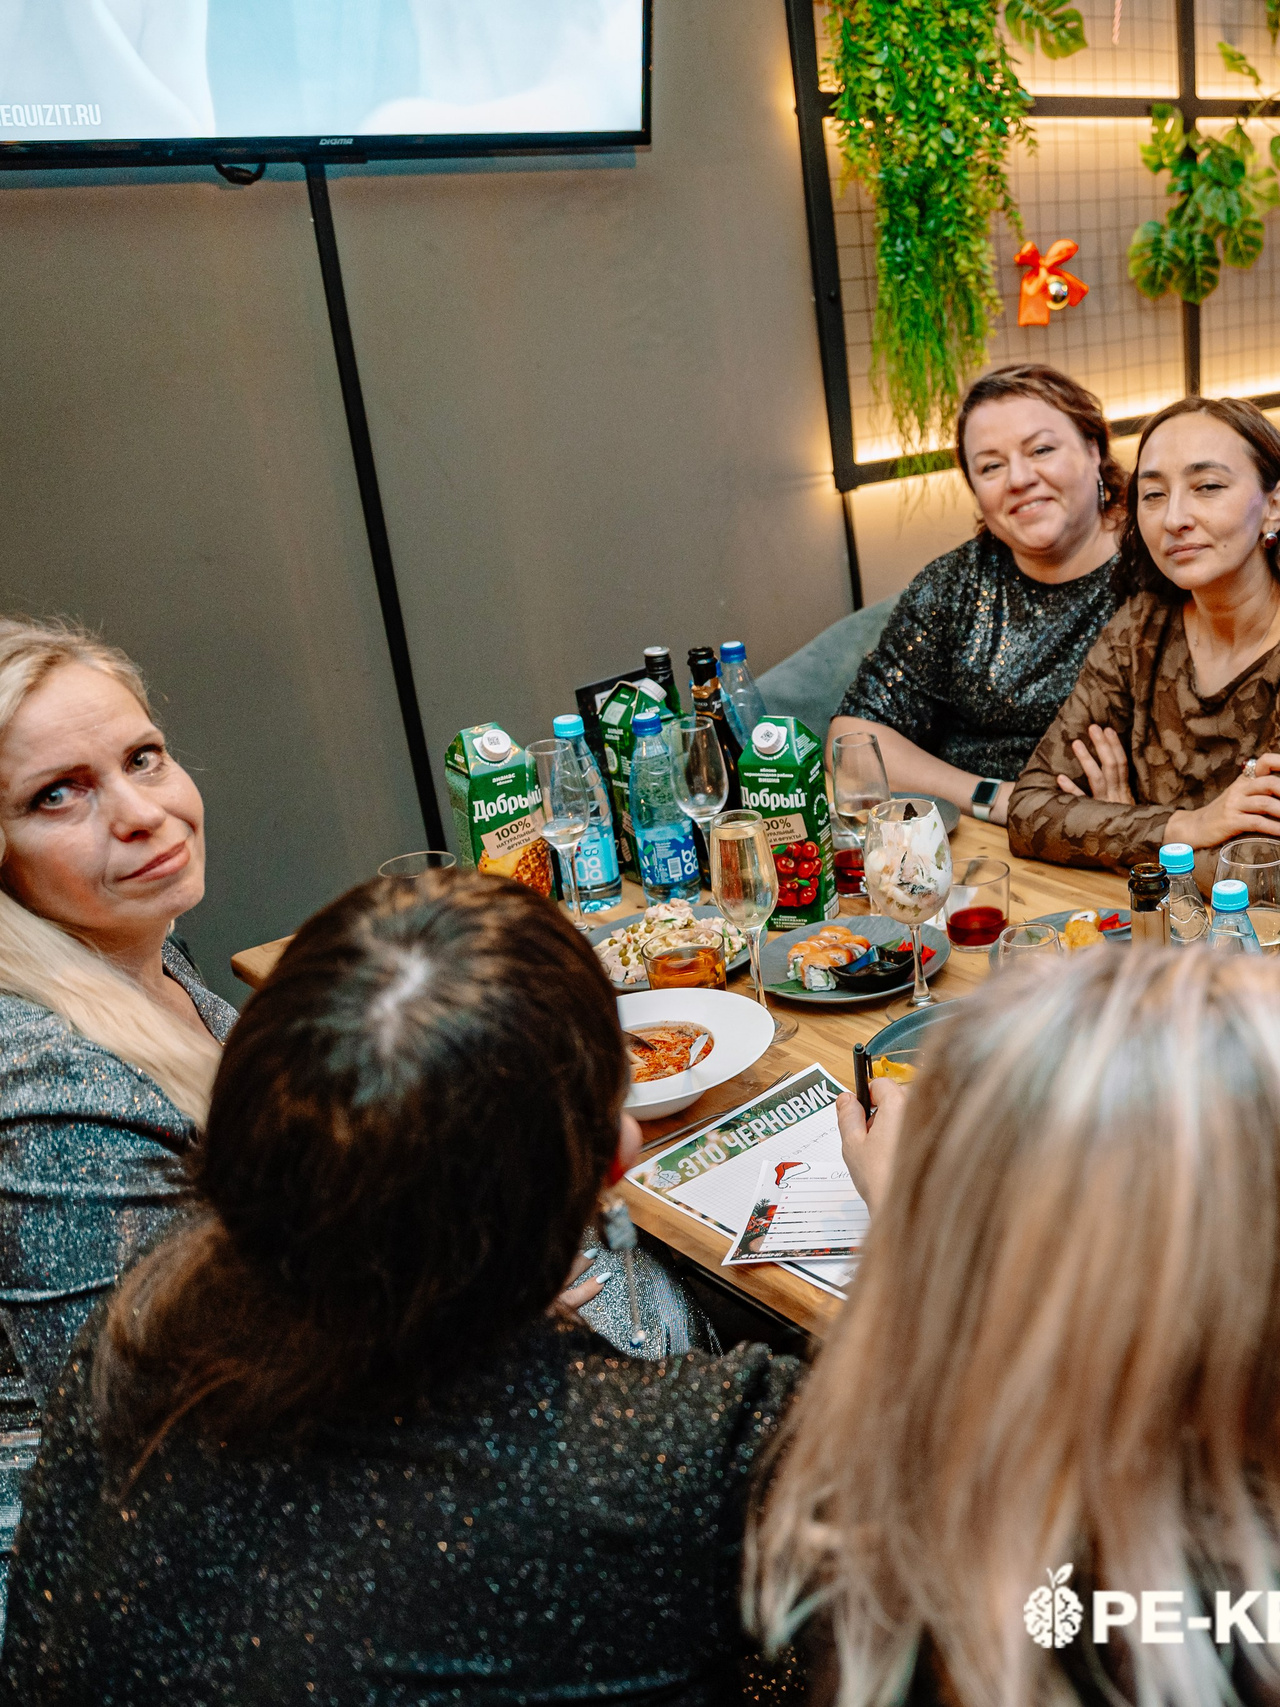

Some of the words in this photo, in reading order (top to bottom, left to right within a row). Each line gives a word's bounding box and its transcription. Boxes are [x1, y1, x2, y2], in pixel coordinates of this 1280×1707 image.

[0, 103, 102, 127] EQUIZIT.RU
[473, 784, 543, 824] Добрый
[740, 785, 807, 811] Добрый
[495, 818, 531, 841] 100%
[763, 817, 792, 831] 00%
[677, 1142, 727, 1178] ЭТО
[721, 1079, 839, 1150] ЧЕРНОВИК
